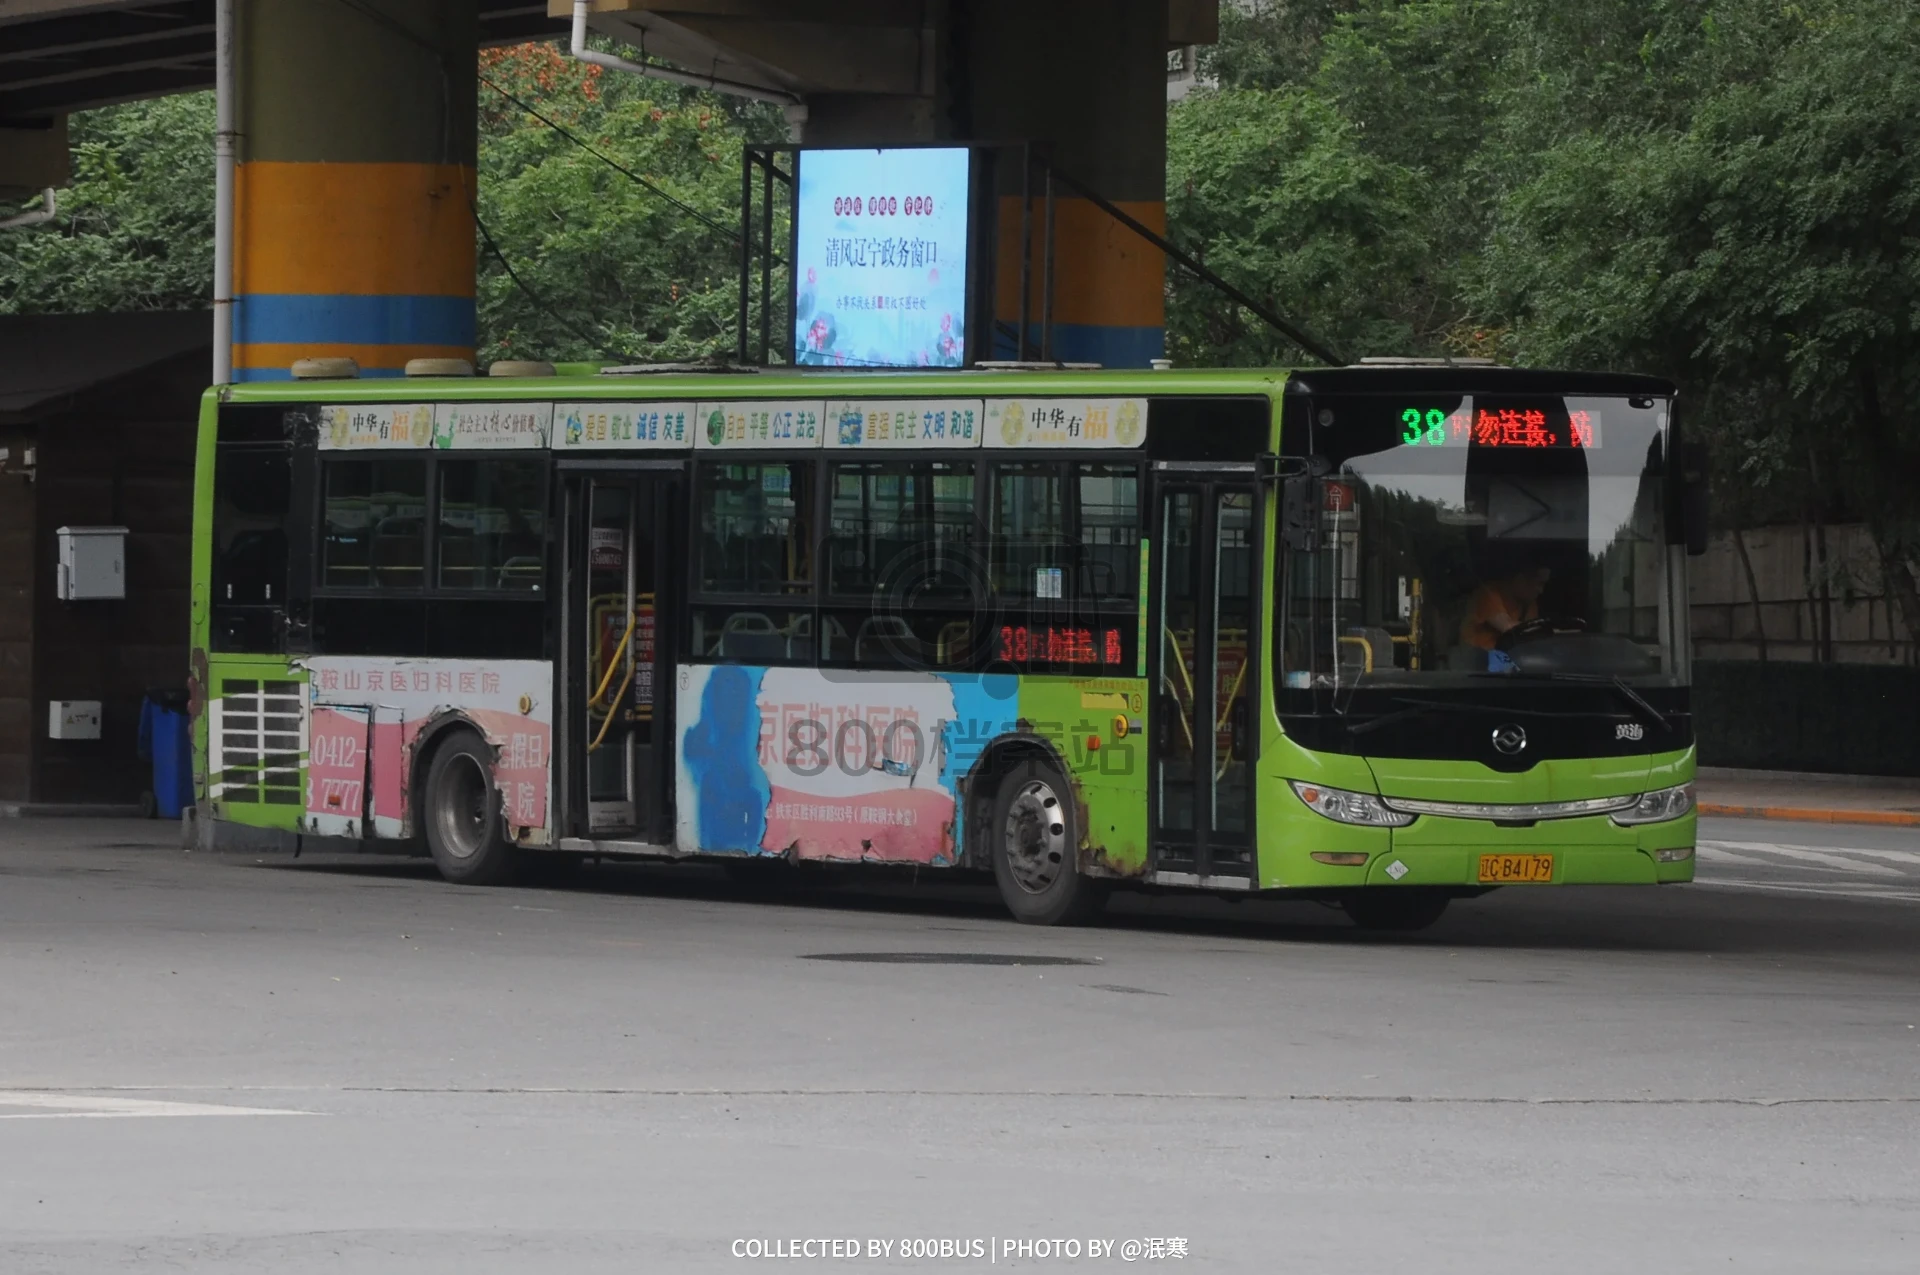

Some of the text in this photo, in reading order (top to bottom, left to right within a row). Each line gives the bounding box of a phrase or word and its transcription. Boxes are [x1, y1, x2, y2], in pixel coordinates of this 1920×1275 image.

[825, 237, 937, 268] 清风辽宁政务窗口
[637, 412, 658, 440] 诚信
[662, 412, 685, 440] 友善
[773, 412, 793, 438] 公正
[895, 410, 917, 439] 民主
[923, 410, 945, 439] 文明
[951, 409, 974, 439] 和谐
[1031, 404, 1109, 440] 中华有福
[1402, 408, 1446, 446] 38
[1001, 626, 1028, 662] 38
[320, 668, 500, 694] 鞍山京医妇科医院
